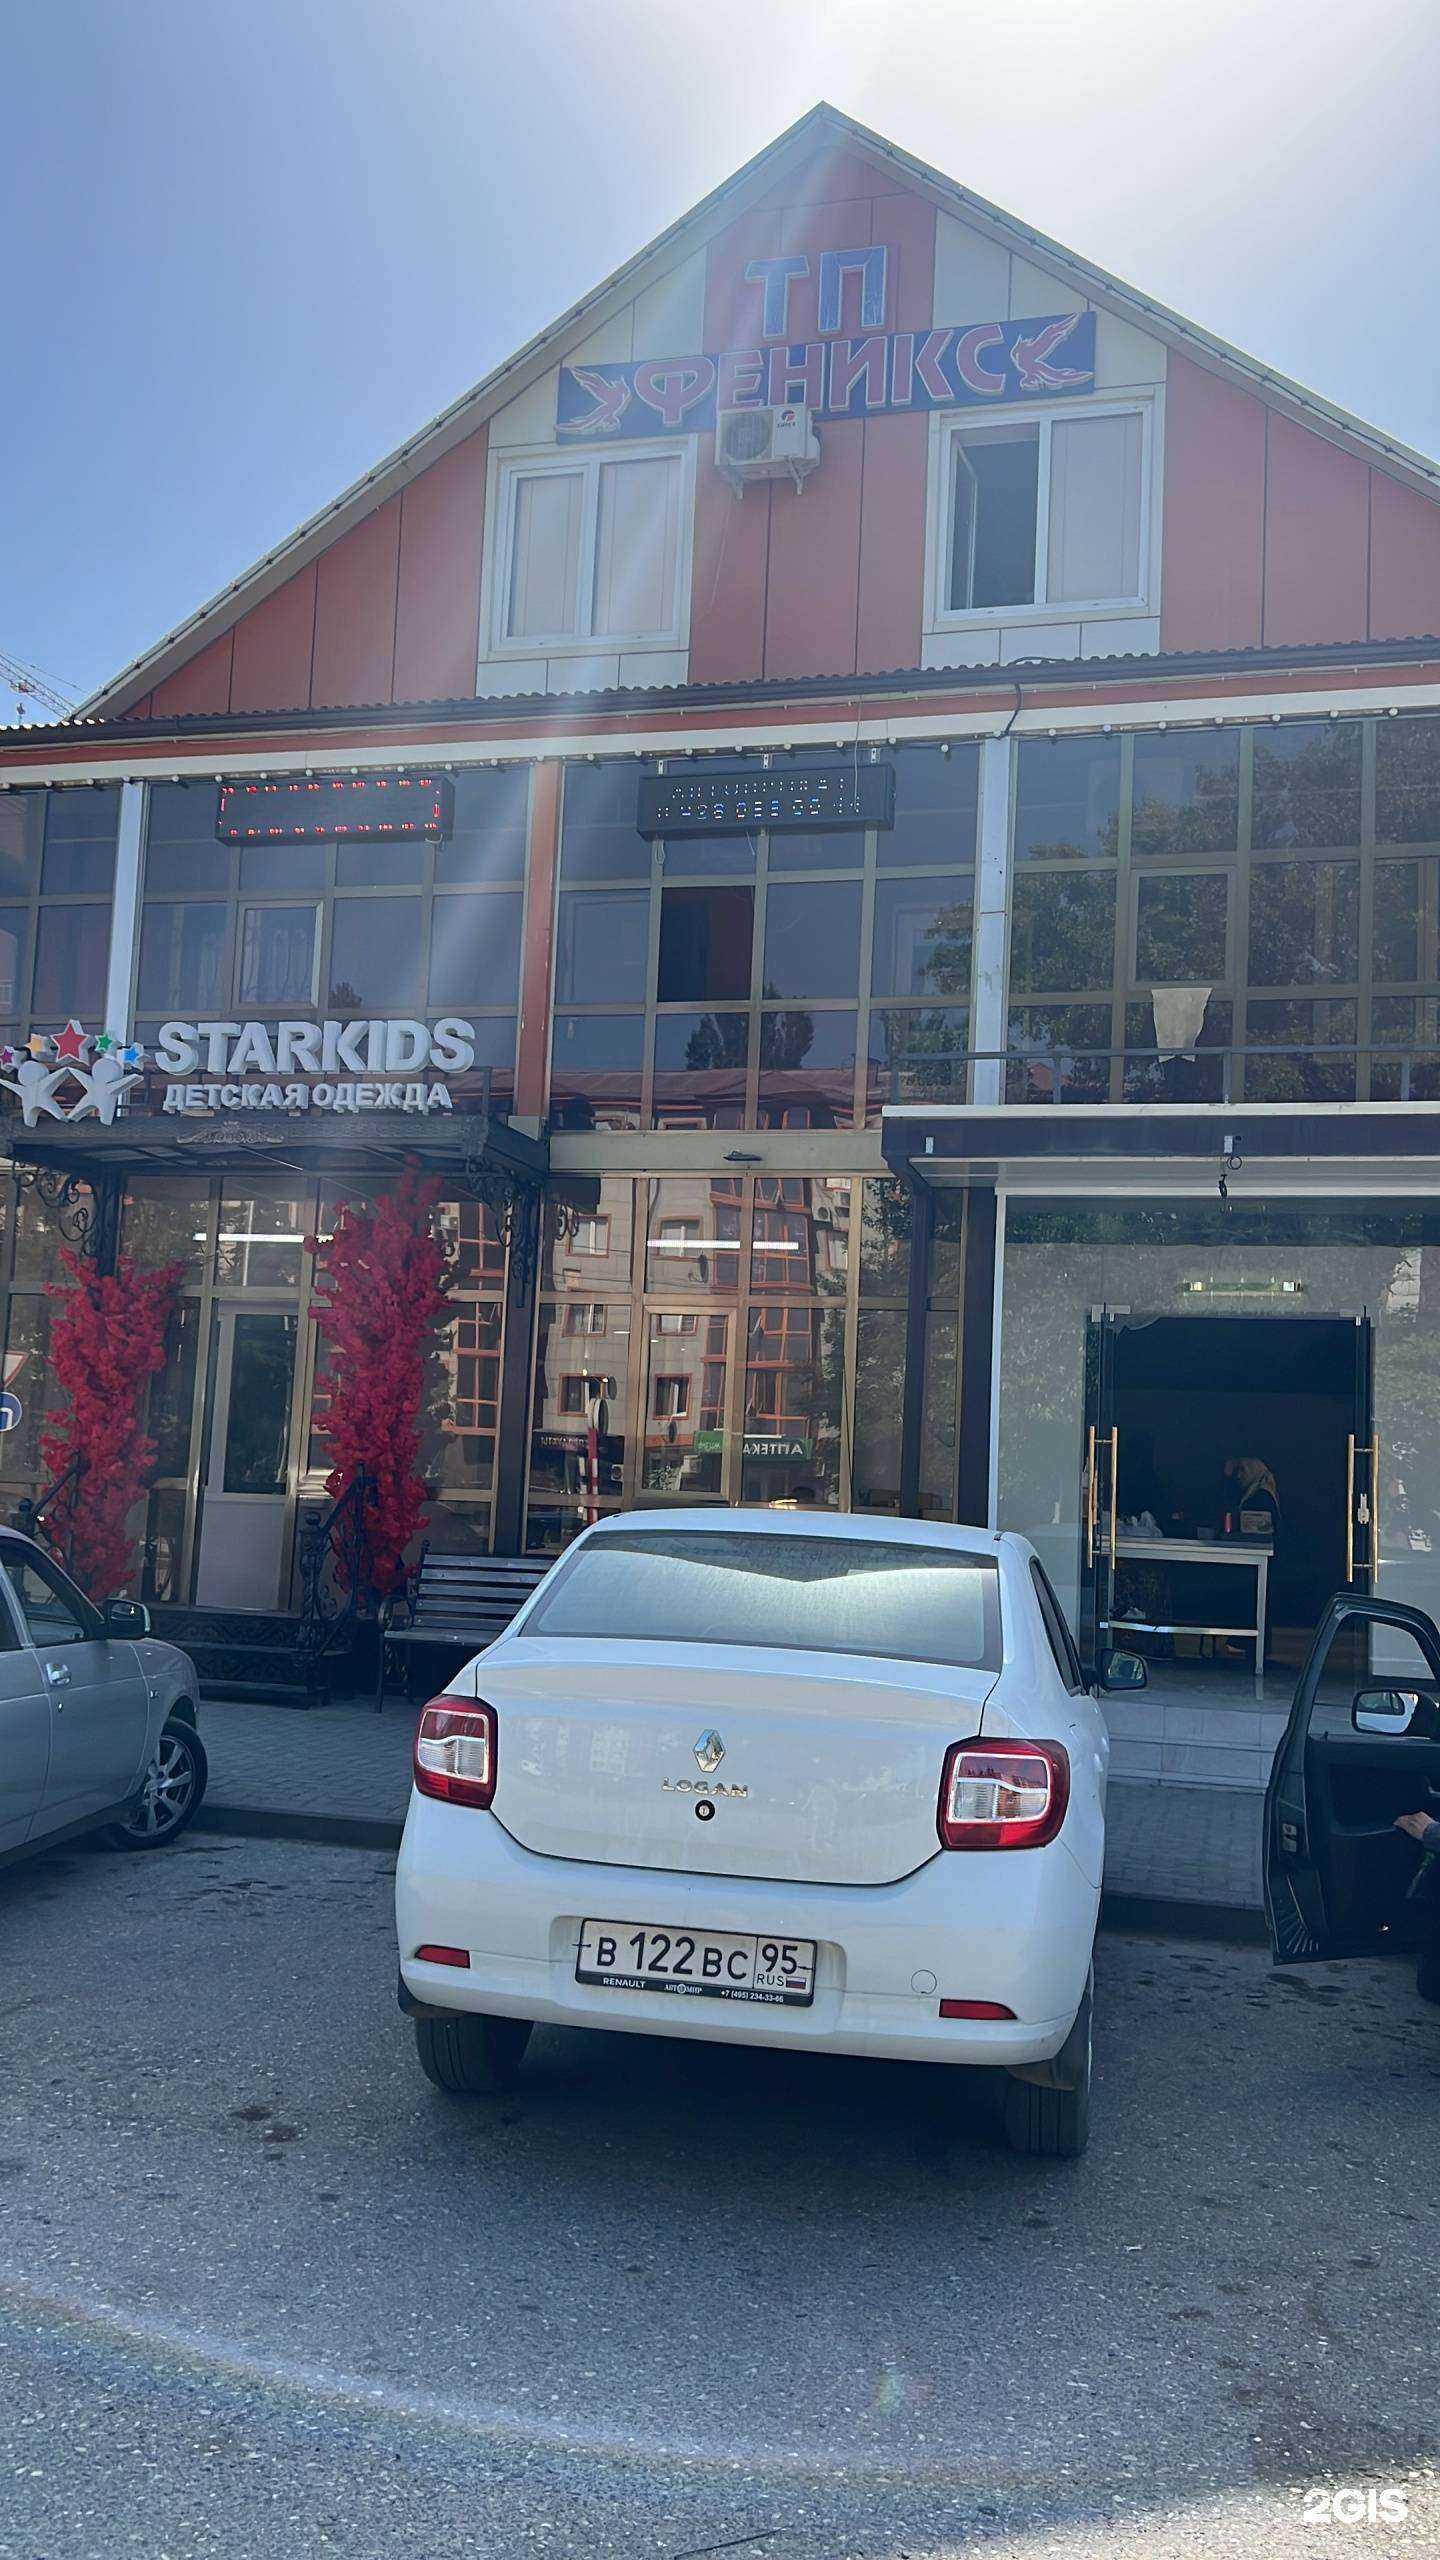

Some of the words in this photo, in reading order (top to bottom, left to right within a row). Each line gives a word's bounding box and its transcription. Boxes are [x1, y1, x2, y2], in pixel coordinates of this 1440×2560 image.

[745, 246, 887, 340] ТП
[633, 325, 1006, 427] ФЕНИКС
[155, 1018, 475, 1075] STARKIDS
[164, 1084, 309, 1112] ДЕТСКАЯ
[312, 1083, 452, 1114] ОДЕЖДА
[662, 1777, 748, 1797] LOGAN
[761, 1944, 798, 1975] 95
[603, 1978, 646, 1989] RENAULT
[757, 1973, 784, 1987] RUS
